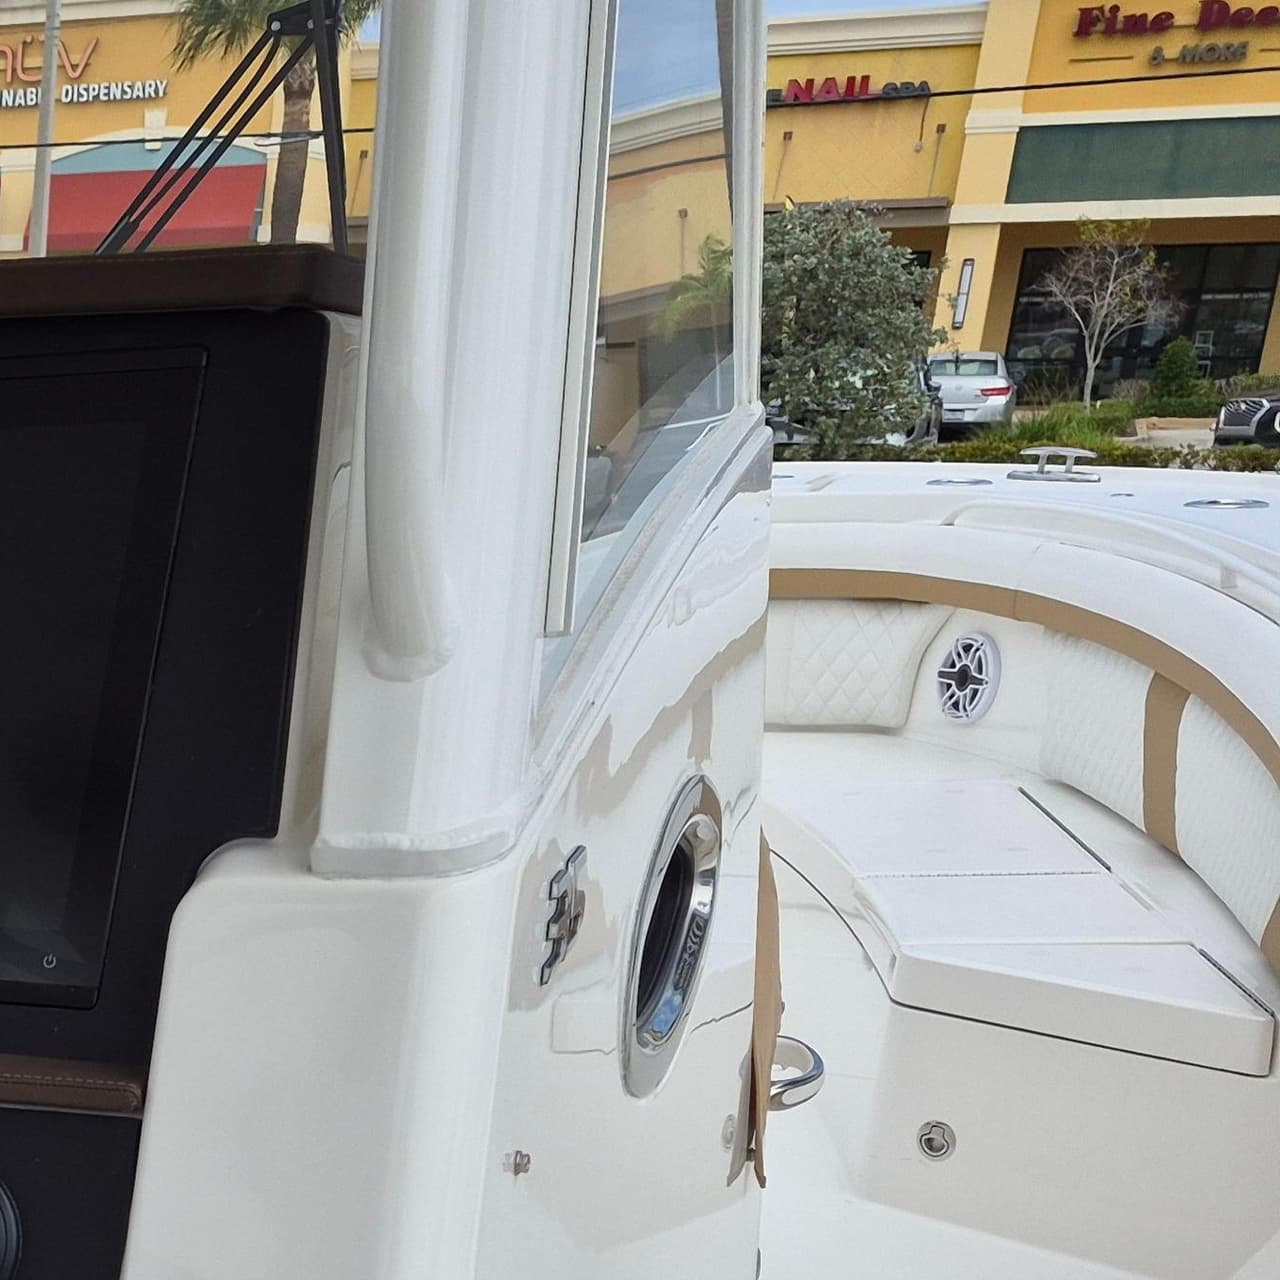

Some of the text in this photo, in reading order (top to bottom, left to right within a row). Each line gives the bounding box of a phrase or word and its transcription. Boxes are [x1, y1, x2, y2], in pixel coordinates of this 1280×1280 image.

[1073, 4, 1175, 37] Fine
[1149, 41, 1250, 66] & MORE
[61, 79, 169, 105] DISPENSARY
[784, 75, 882, 103] NAIL
